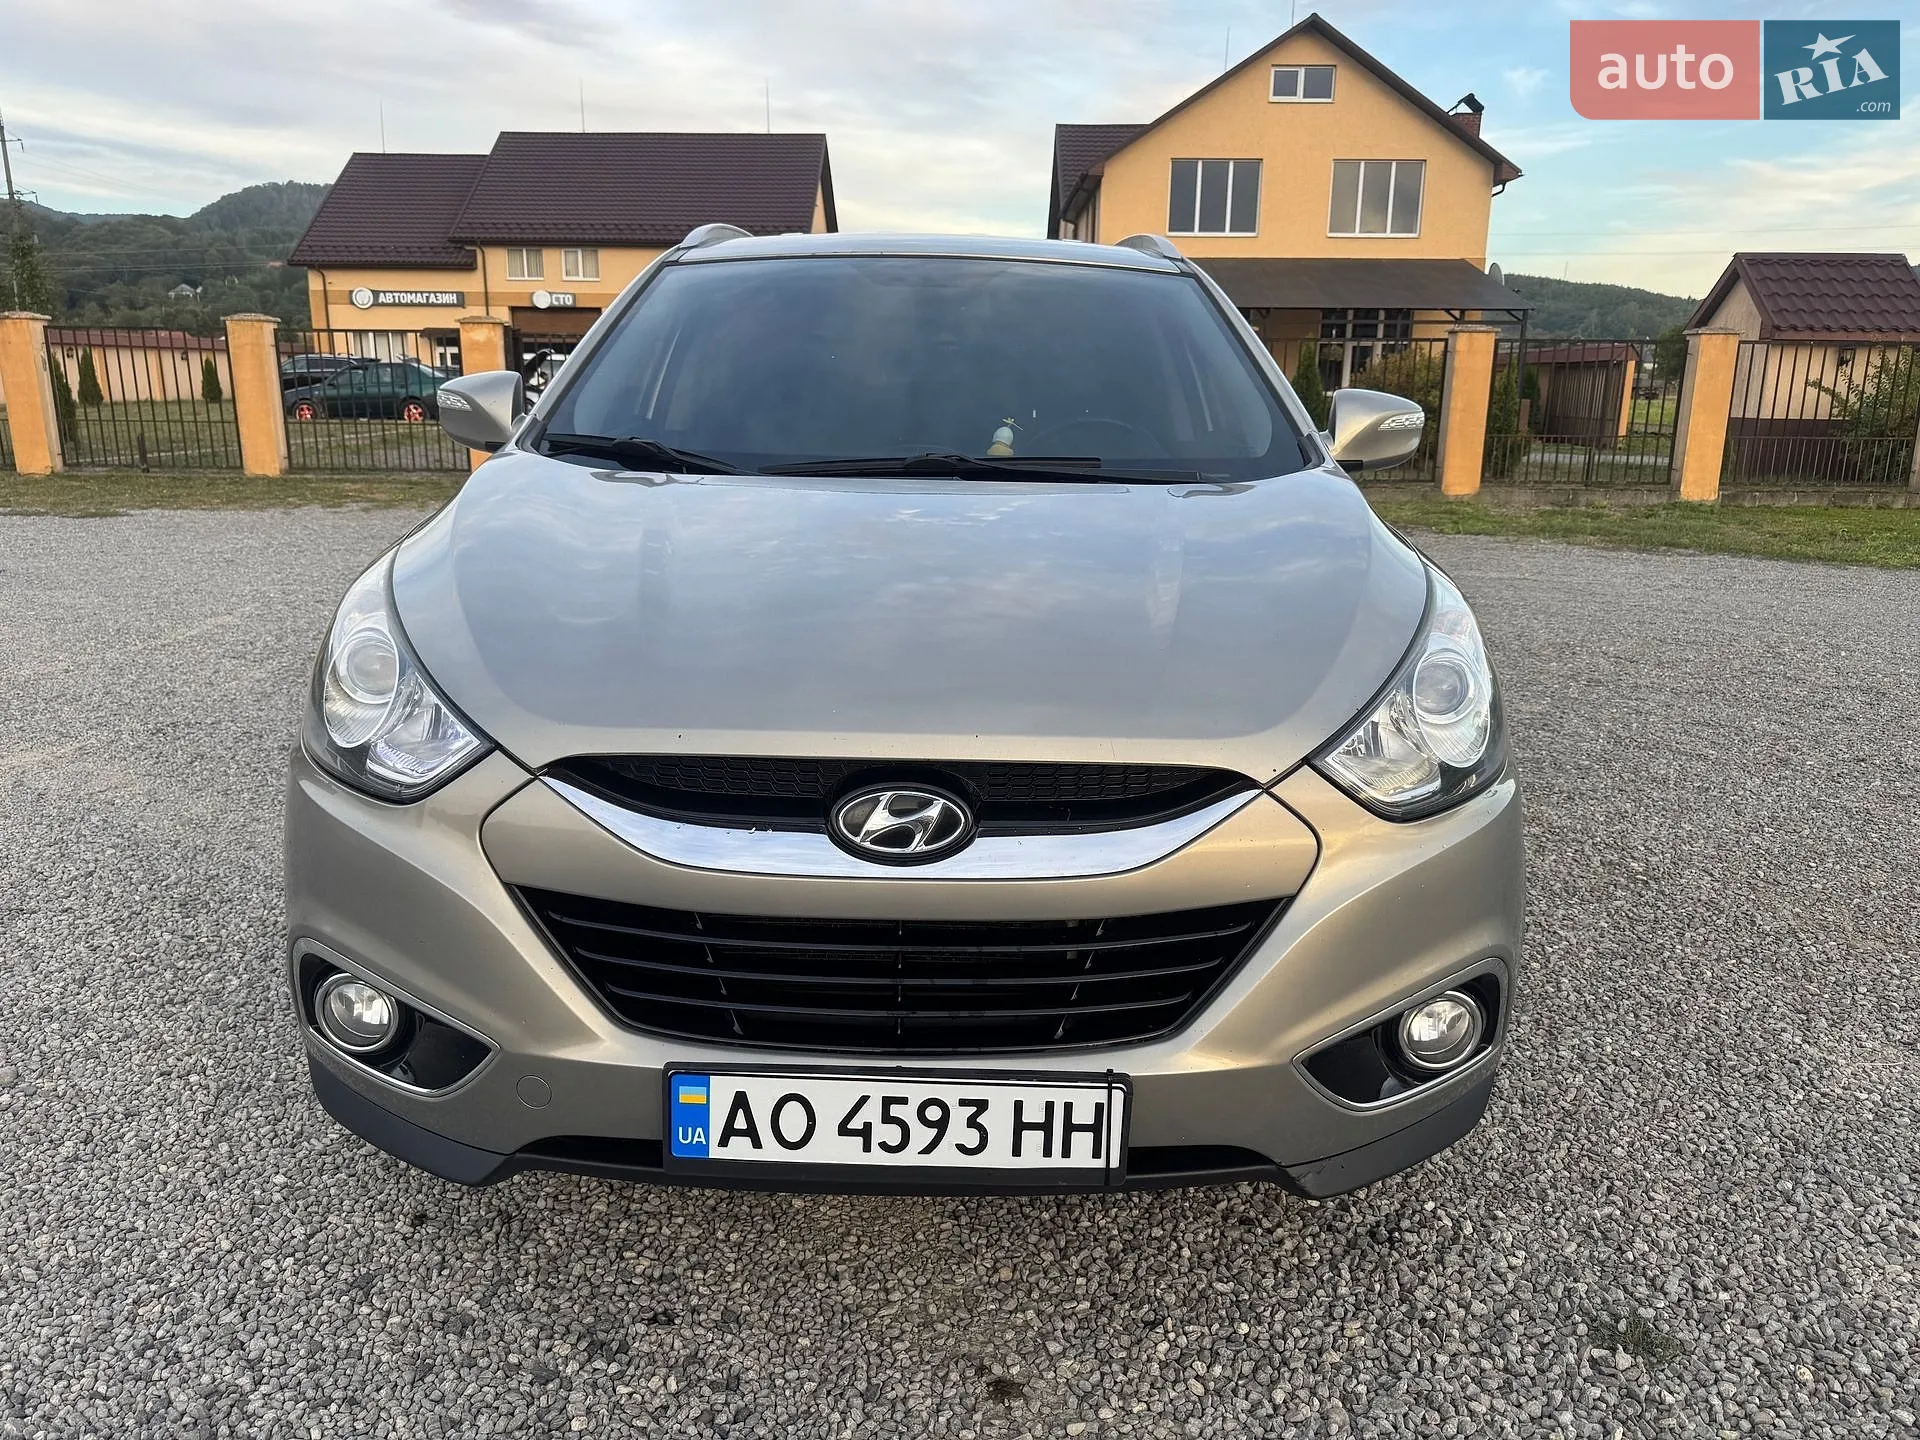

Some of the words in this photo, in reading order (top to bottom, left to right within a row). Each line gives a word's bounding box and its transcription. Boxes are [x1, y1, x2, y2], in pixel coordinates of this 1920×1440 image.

[378, 292, 457, 305] АВТОМАГАЗИН
[551, 294, 573, 306] СТО
[717, 1090, 817, 1151] AO
[837, 1095, 989, 1157] 4593
[1011, 1099, 1105, 1159] HH
[678, 1127, 707, 1145] UA
